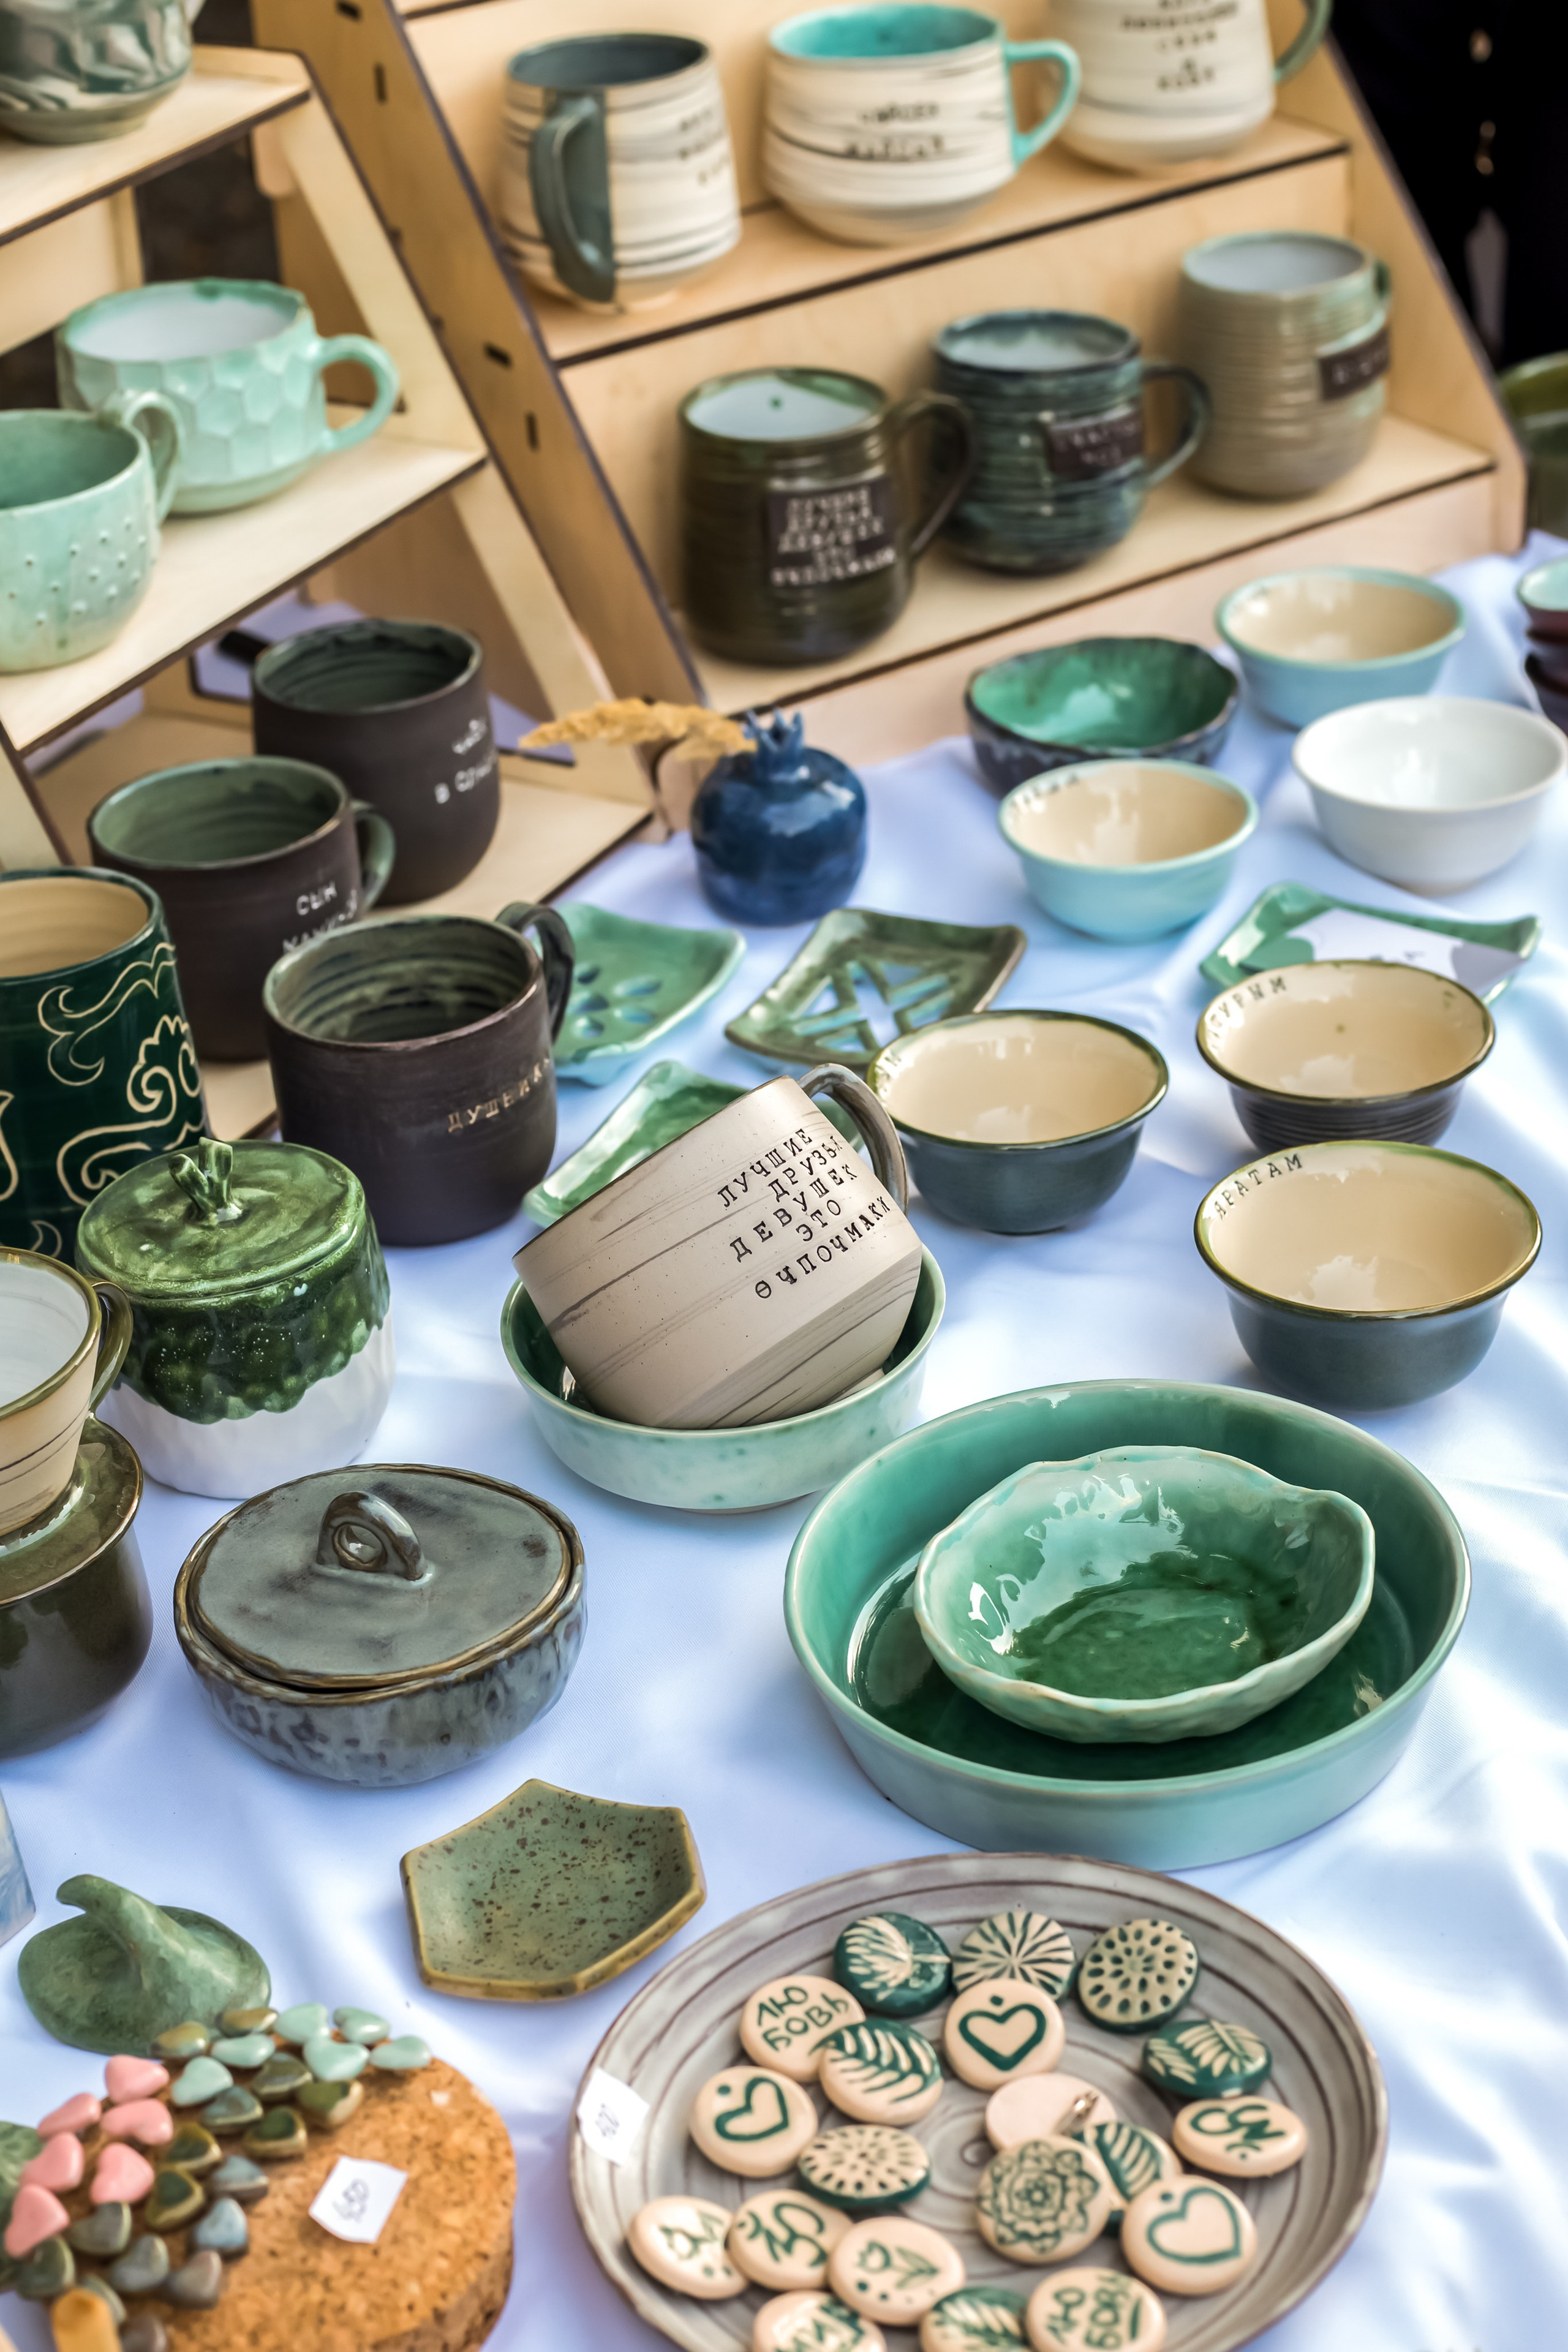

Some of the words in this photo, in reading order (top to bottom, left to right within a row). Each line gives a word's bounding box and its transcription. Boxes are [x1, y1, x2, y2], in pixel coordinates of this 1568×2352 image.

[717, 1129, 813, 1207] ЛУЧШИЕ
[1214, 1153, 1303, 1220] ЯРАТАМ
[729, 1164, 859, 1263] ДЕВУШЕК
[796, 1199, 842, 1242] ЭТО
[757, 1985, 809, 2027] ЛЮ
[762, 1992, 850, 2052] БОВЬ
